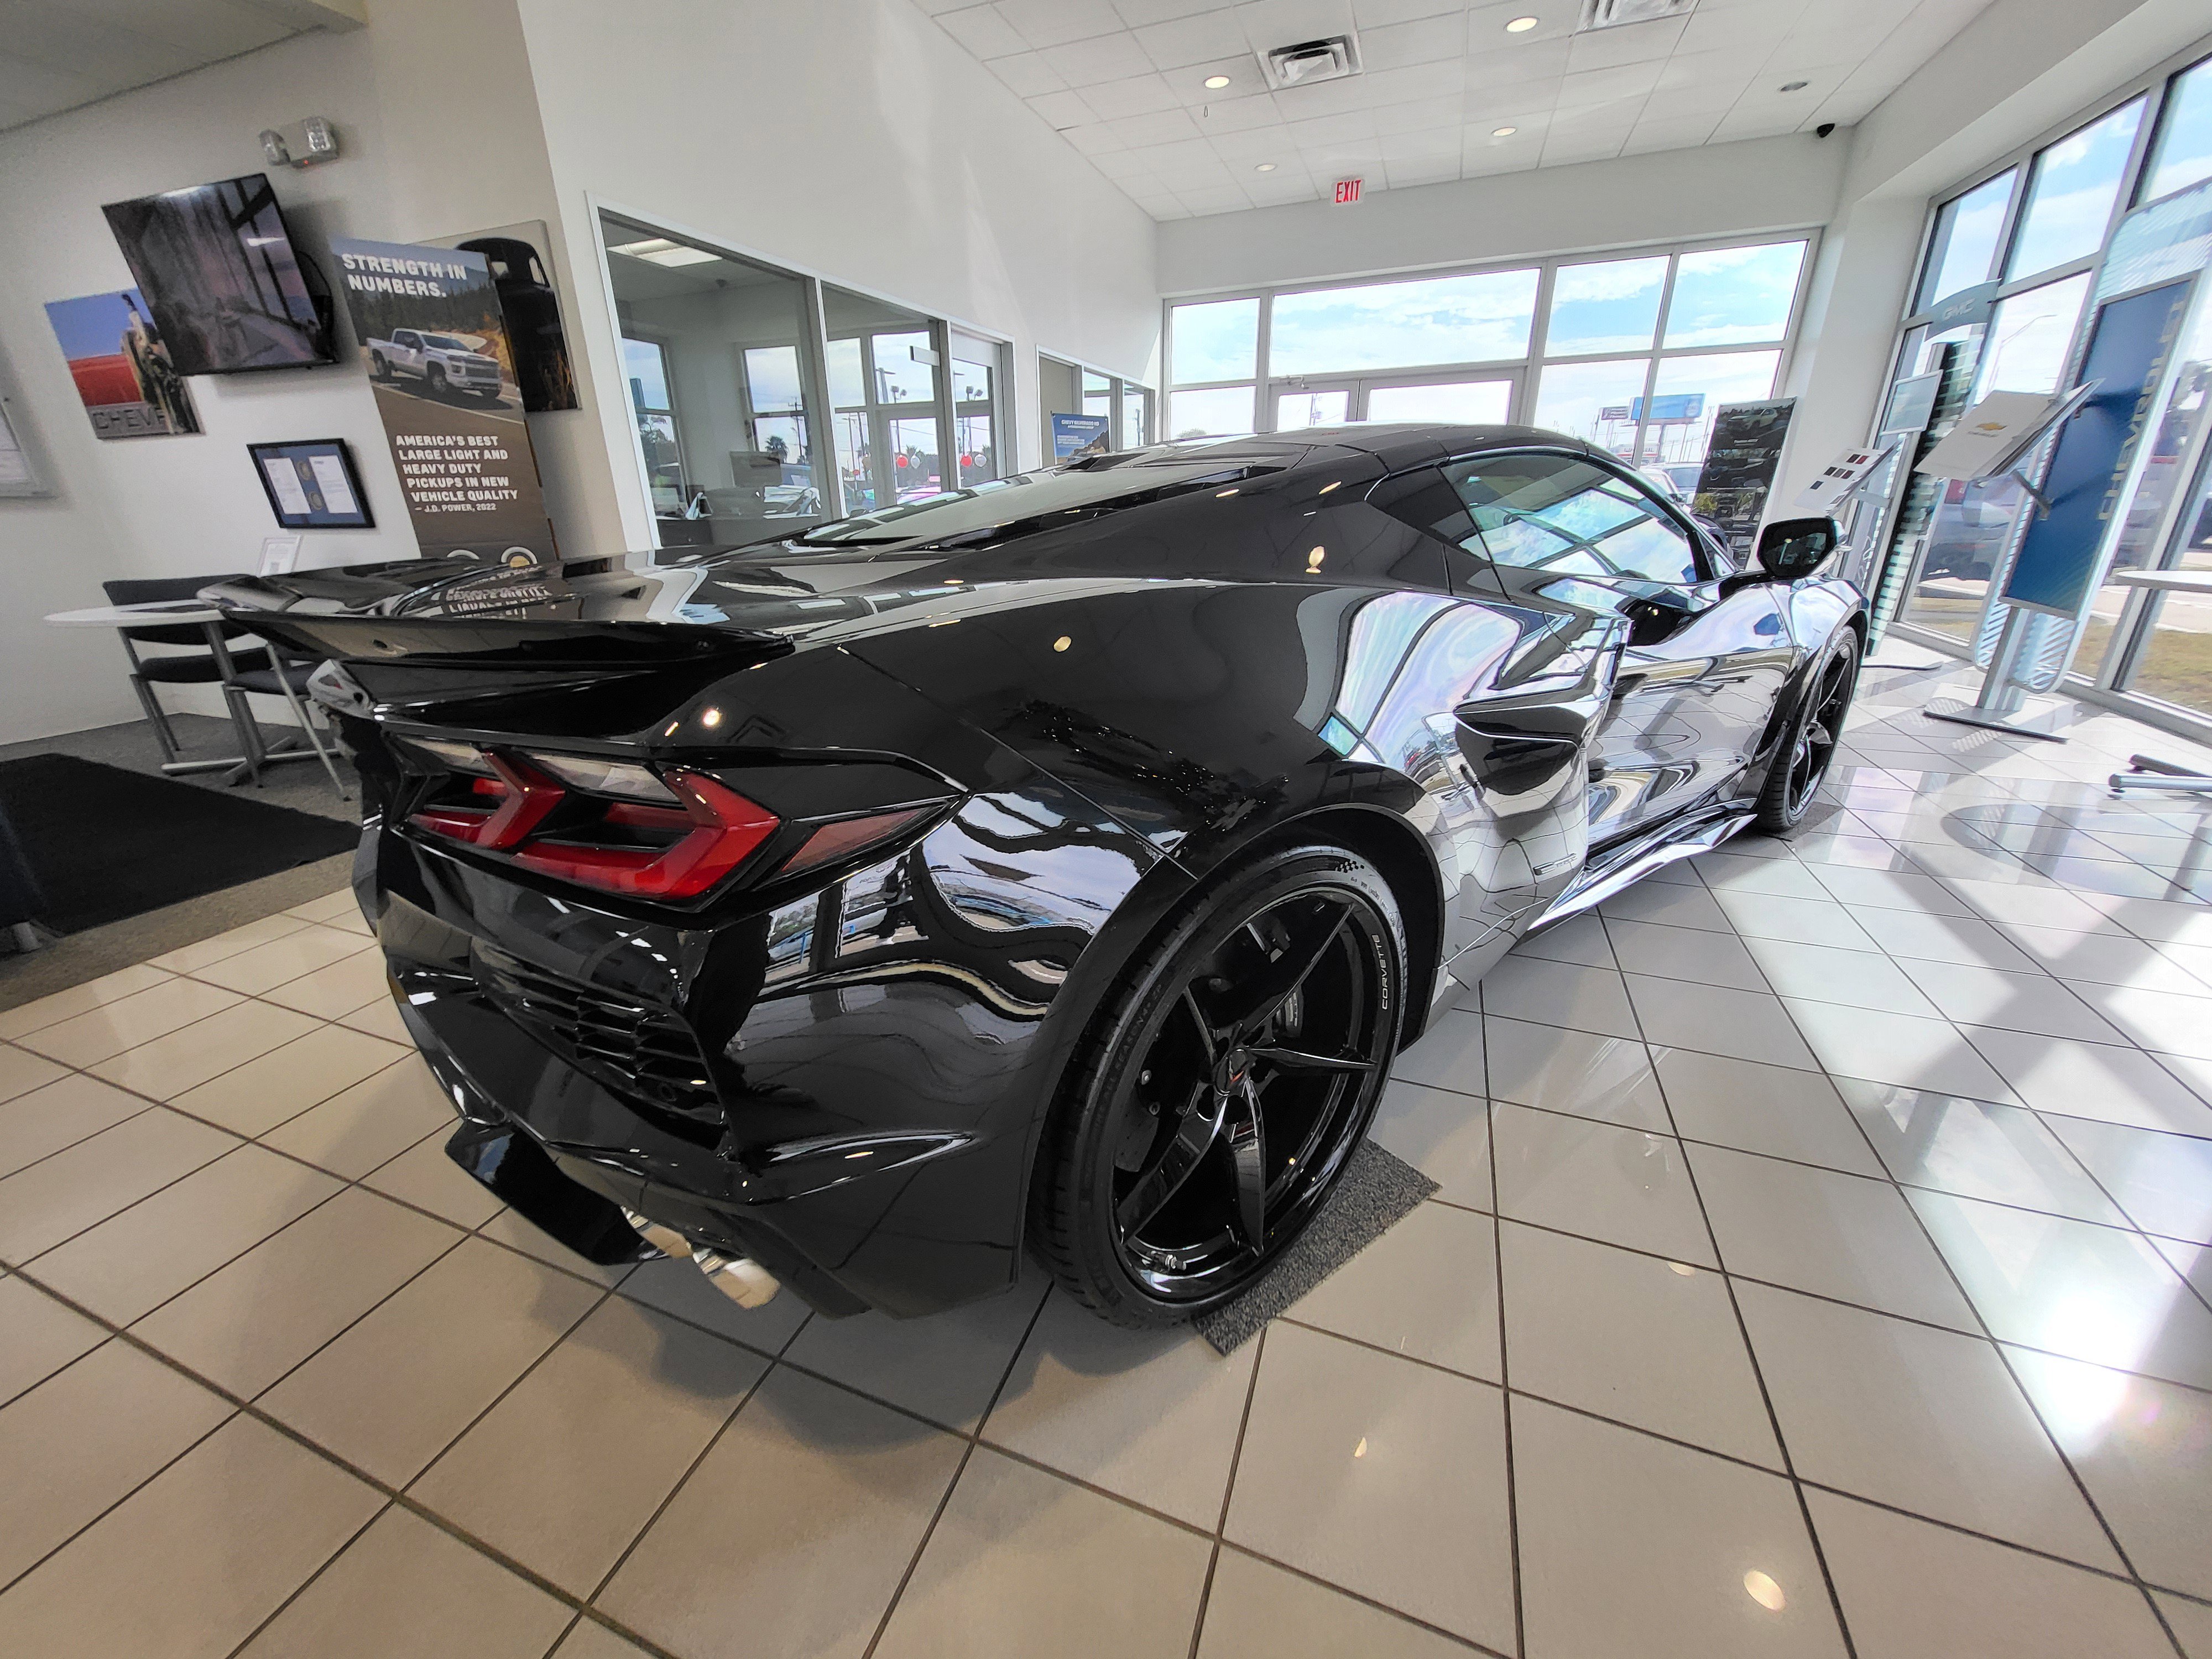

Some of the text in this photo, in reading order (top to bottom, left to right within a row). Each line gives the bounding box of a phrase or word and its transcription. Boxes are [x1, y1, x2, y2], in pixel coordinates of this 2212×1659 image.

[1335, 180, 1361, 203] EXIT
[341, 253, 467, 280] STRENGTH IN
[347, 274, 447, 298] NUMBERS.
[1944, 299, 1975, 321] GMC
[396, 435, 498, 446] AMERICA'S BEST
[398, 449, 508, 461] LARGE LIGHT AND
[402, 463, 482, 474] HEAVY DUTY
[406, 476, 509, 488] PICKUPS IN NEW
[410, 489, 518, 502] VEHICLE QUALITY
[442, 504, 475, 512] POWER,
[1371, 935, 1388, 1010] CORVETTE
